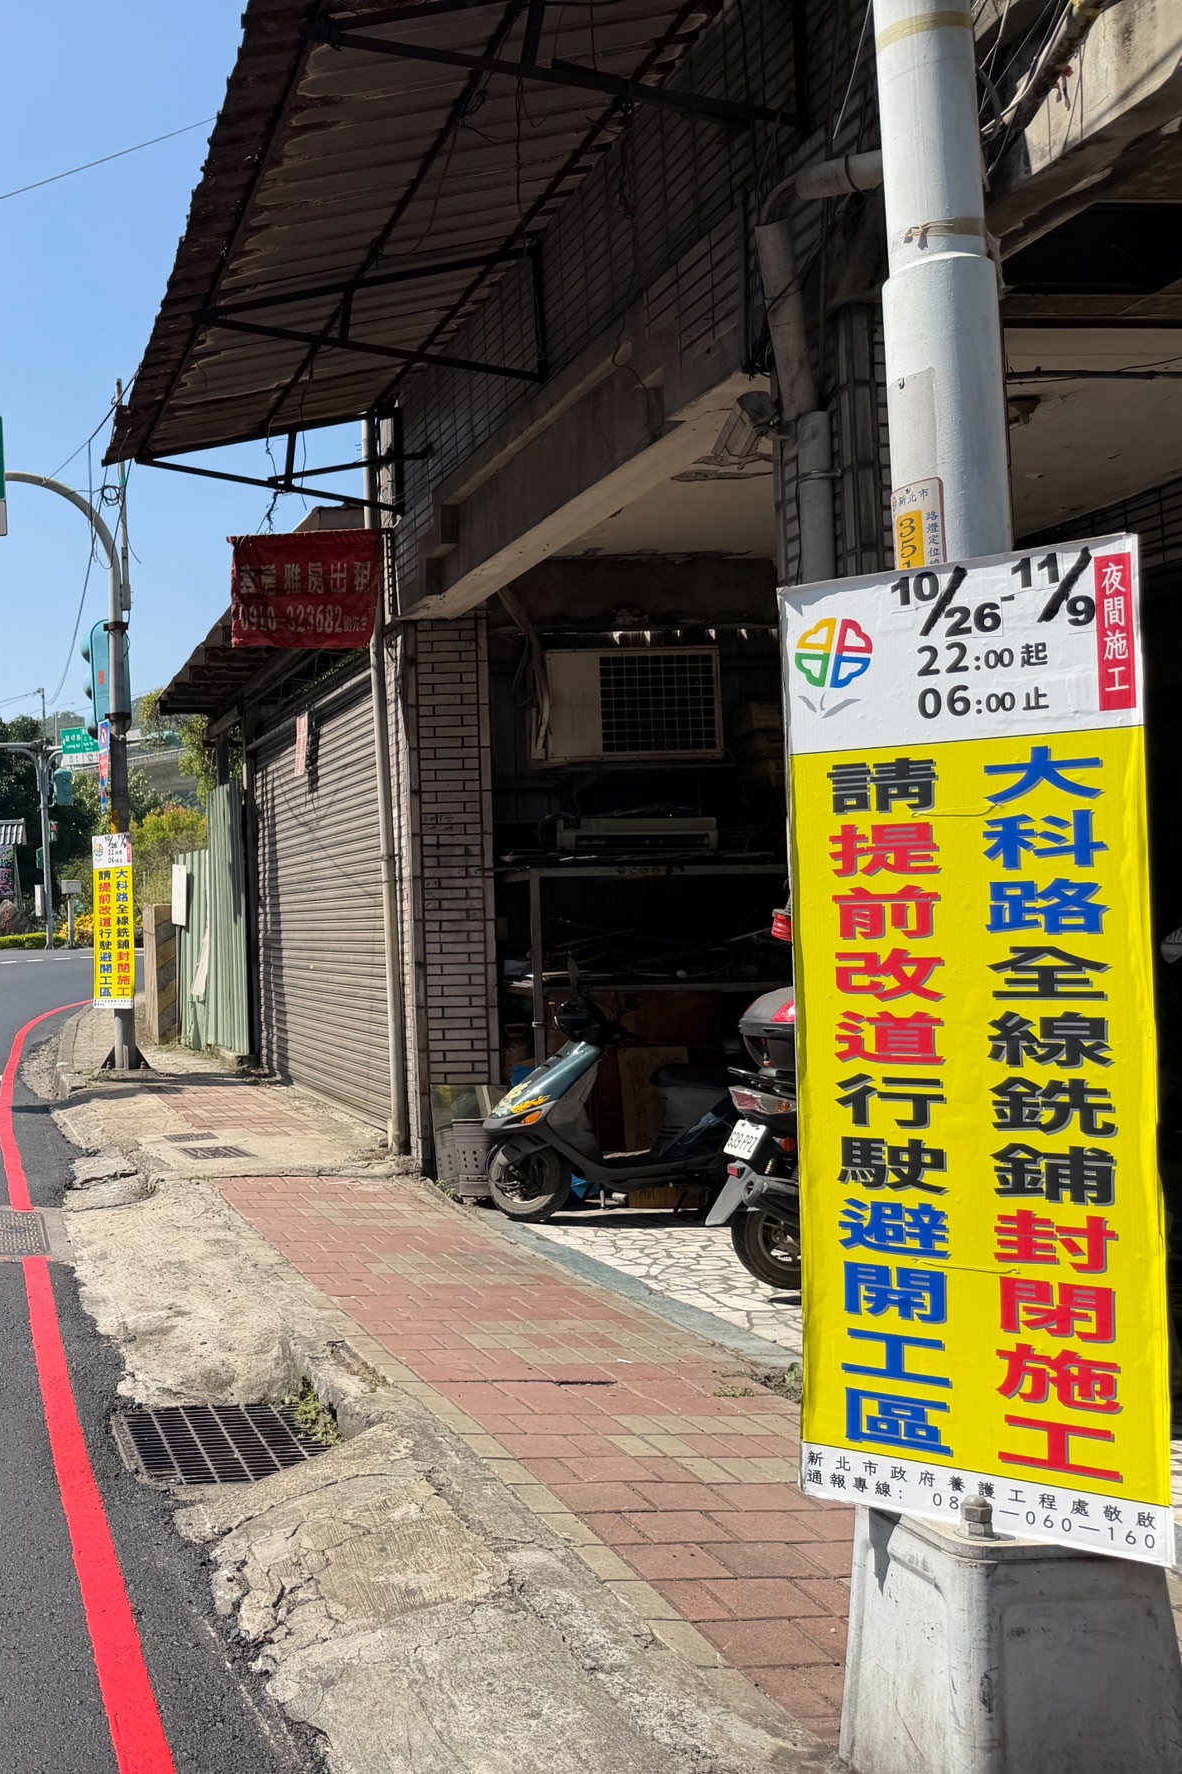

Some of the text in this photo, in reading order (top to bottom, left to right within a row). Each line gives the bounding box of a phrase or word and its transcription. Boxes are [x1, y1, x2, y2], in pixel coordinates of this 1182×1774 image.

[898, 488, 930, 506] 新北市
[1101, 562, 1130, 693] 夜間施工
[827, 758, 954, 1457] 請提前改道行駛避開工區
[983, 745, 1124, 1483] 大科路全線銑鋪封閉施工
[807, 1450, 1156, 1530] 新北市政府養護工程處敬啟
